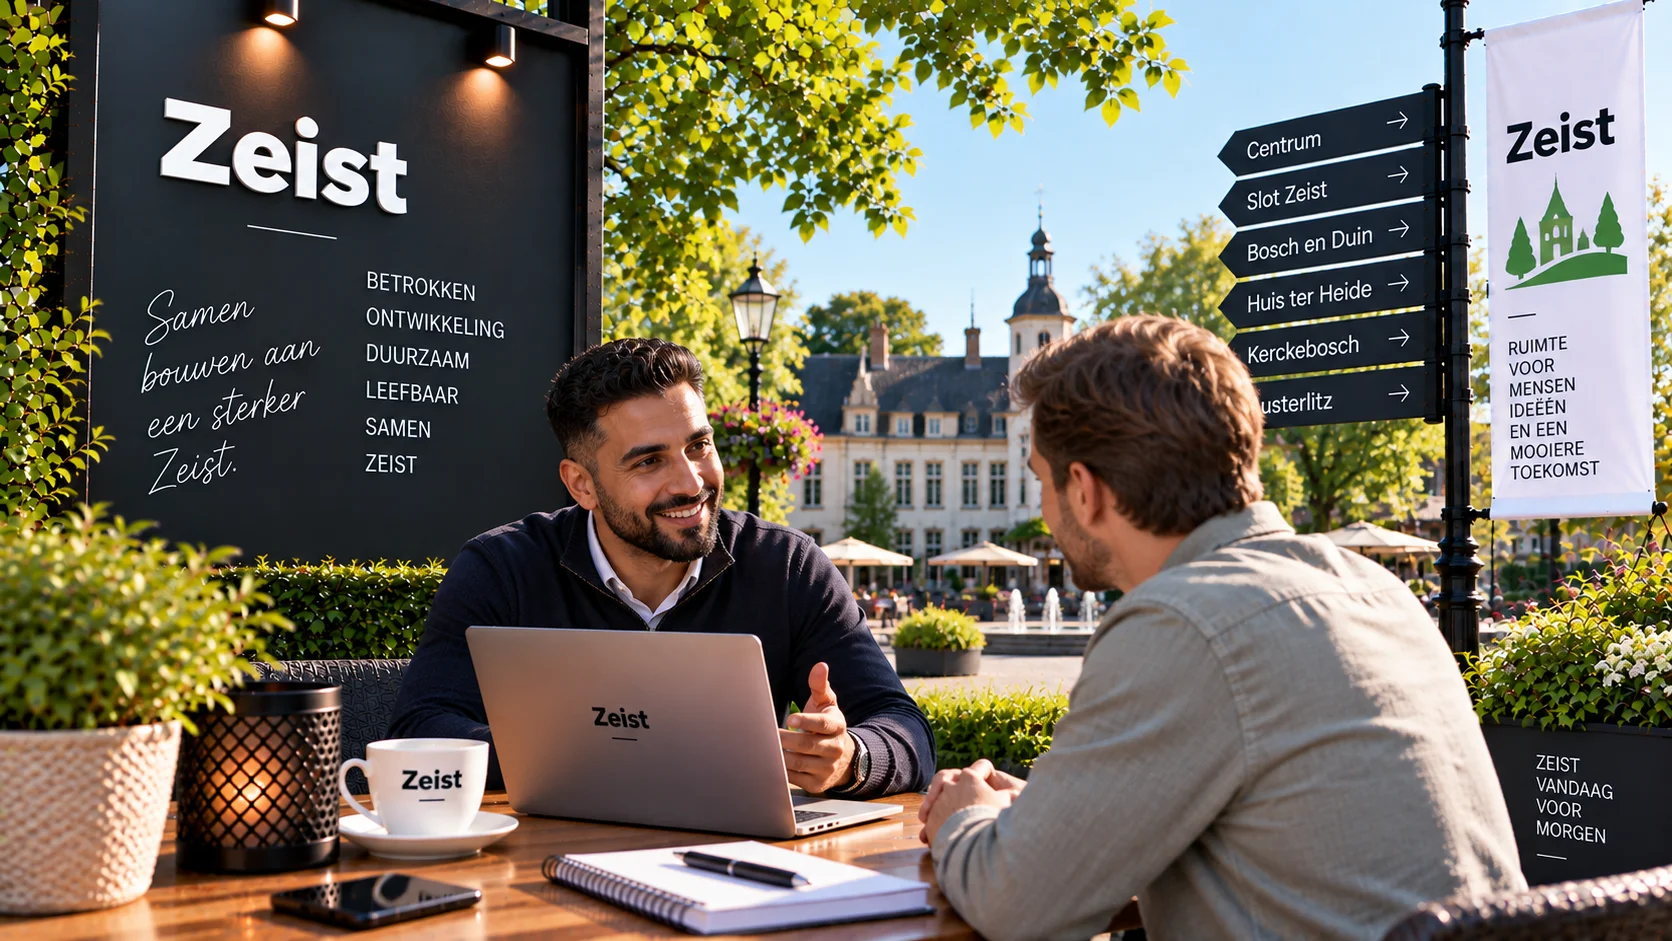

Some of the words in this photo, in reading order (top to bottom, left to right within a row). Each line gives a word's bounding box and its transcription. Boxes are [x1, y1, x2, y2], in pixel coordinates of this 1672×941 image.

[1247, 134, 1320, 159] Centrum
[1507, 108, 1615, 164] Zeist
[160, 98, 407, 214] Zeist
[1247, 190, 1280, 210] Slot
[1285, 181, 1327, 204] Zeist
[1248, 237, 1298, 261] Bosch
[1305, 237, 1325, 252] en
[1332, 227, 1372, 248] Duin
[368, 271, 475, 301] BETROKKEN
[1248, 292, 1284, 313] Huis
[1289, 291, 1314, 307] ter
[1320, 280, 1372, 303] Heide
[145, 290, 255, 345] Samen
[367, 307, 504, 338] ONTWIKKELING
[367, 344, 468, 369] DUURZAAM
[1248, 335, 1359, 363] Kerckebosch
[1509, 336, 1567, 355] RUIMTE
[141, 353, 253, 393] bouwen
[265, 341, 320, 365] aan
[1509, 358, 1554, 376] VOOR
[367, 381, 458, 404] LEEFBAAR
[1510, 377, 1575, 397] MENSEN
[148, 413, 200, 438] een
[212, 379, 305, 430] sterker
[1261, 392, 1332, 414] usterlitz
[1510, 397, 1565, 418] IDEËÉN
[366, 417, 430, 438] SAMEN
[1511, 424, 1530, 438] EN
[1537, 421, 1566, 437] EEN
[1511, 441, 1584, 460] MOOIERE
[149, 440, 236, 495] Zeist.
[366, 454, 417, 473] ZEIST
[1511, 461, 1599, 480] TOEKOMST
[592, 707, 650, 729] Zeist
[1537, 755, 1580, 772] ZEIST
[402, 769, 462, 790] Zeist
[1536, 777, 1613, 799] VANDAAG
[1536, 798, 1581, 818] VOOR
[1537, 820, 1605, 843] MORGEN
